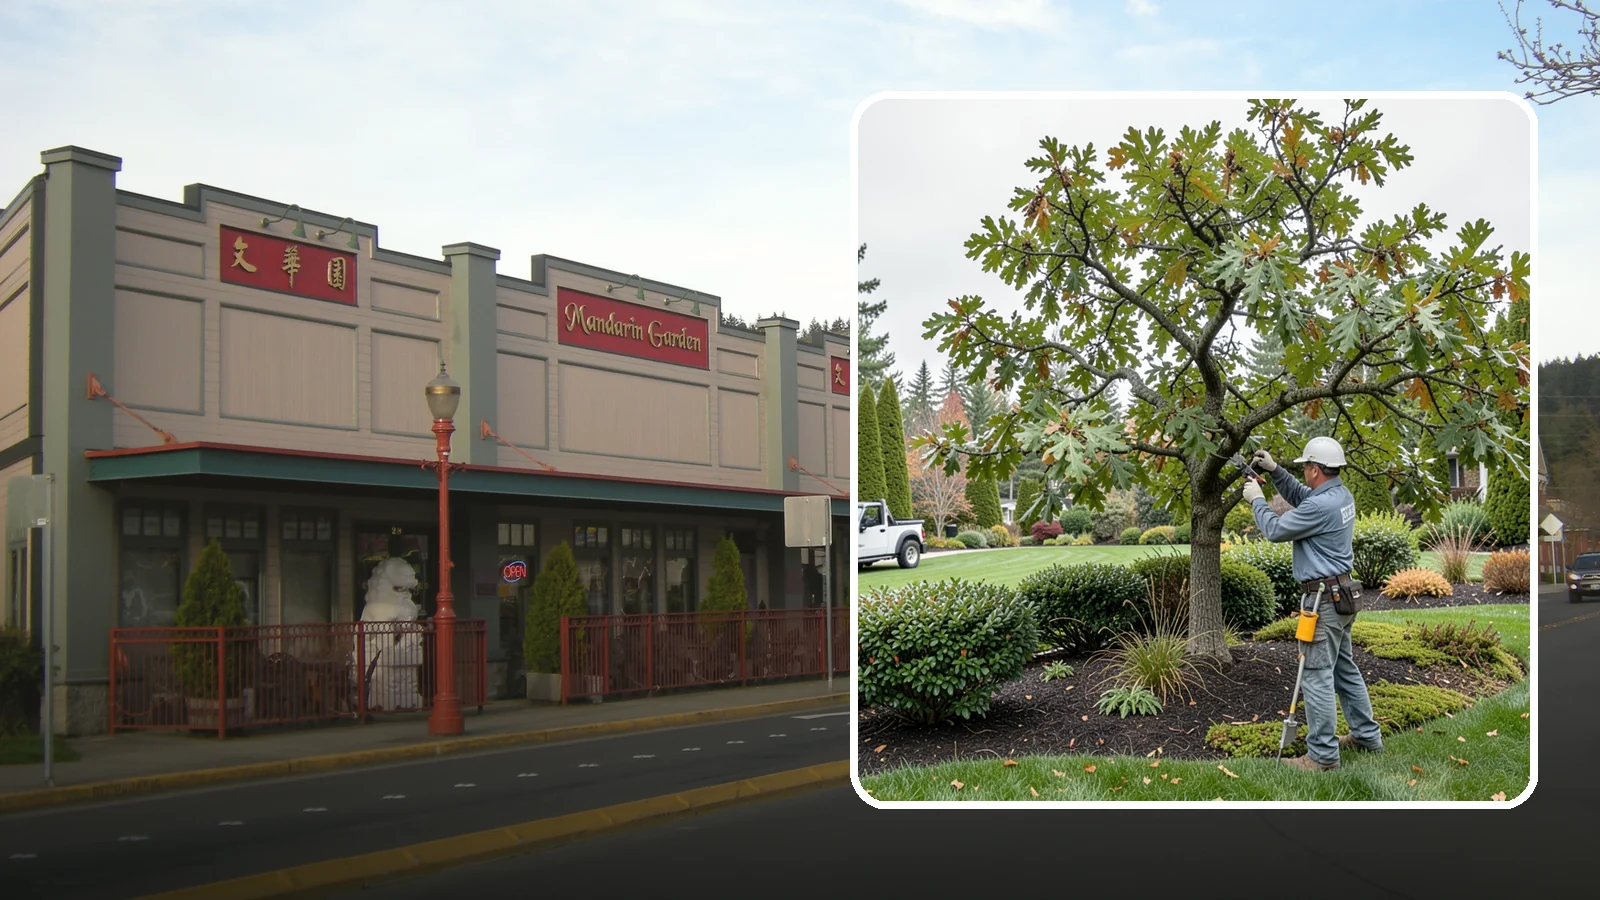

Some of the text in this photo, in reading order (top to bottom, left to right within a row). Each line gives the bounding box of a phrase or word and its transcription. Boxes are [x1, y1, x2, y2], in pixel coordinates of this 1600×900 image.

[231, 236, 346, 291] 文華園
[565, 302, 701, 352] Mandarin Garden
[503, 565, 527, 578] OPEN
